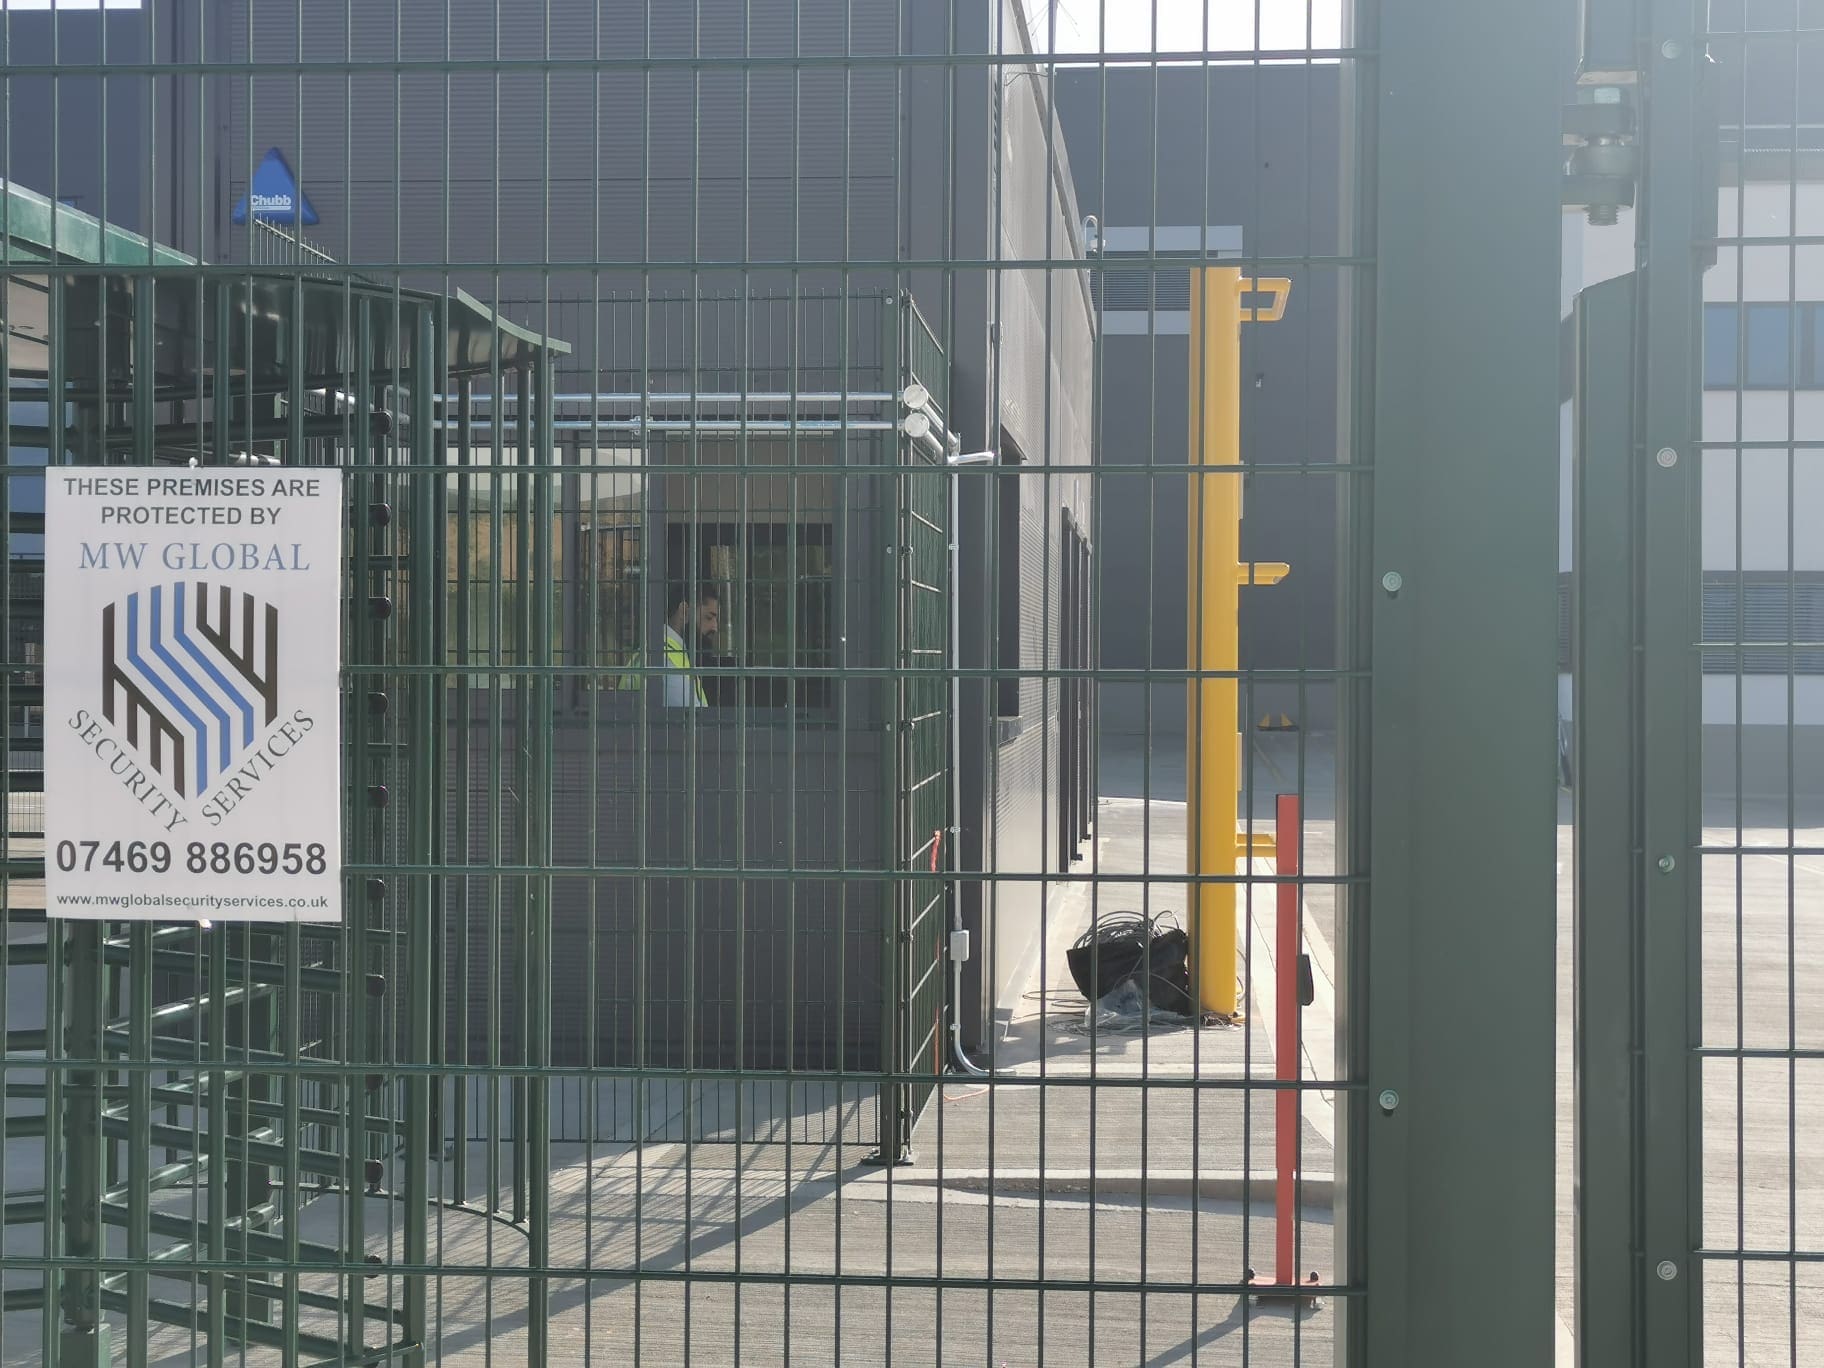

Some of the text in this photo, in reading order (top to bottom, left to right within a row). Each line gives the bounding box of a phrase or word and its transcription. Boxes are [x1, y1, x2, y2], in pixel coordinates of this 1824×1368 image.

[250, 195, 292, 206] Chubb
[64, 477, 320, 497] THESE PREMISES ARE
[101, 506, 282, 525] PROTECTED BY
[78, 542, 311, 571] MW GLOBAL
[68, 709, 314, 832] SECURITY SERVICES
[56, 839, 327, 875] 07469 886958
[56, 893, 329, 910] www.mwglobalsecurityservices.co.uk
